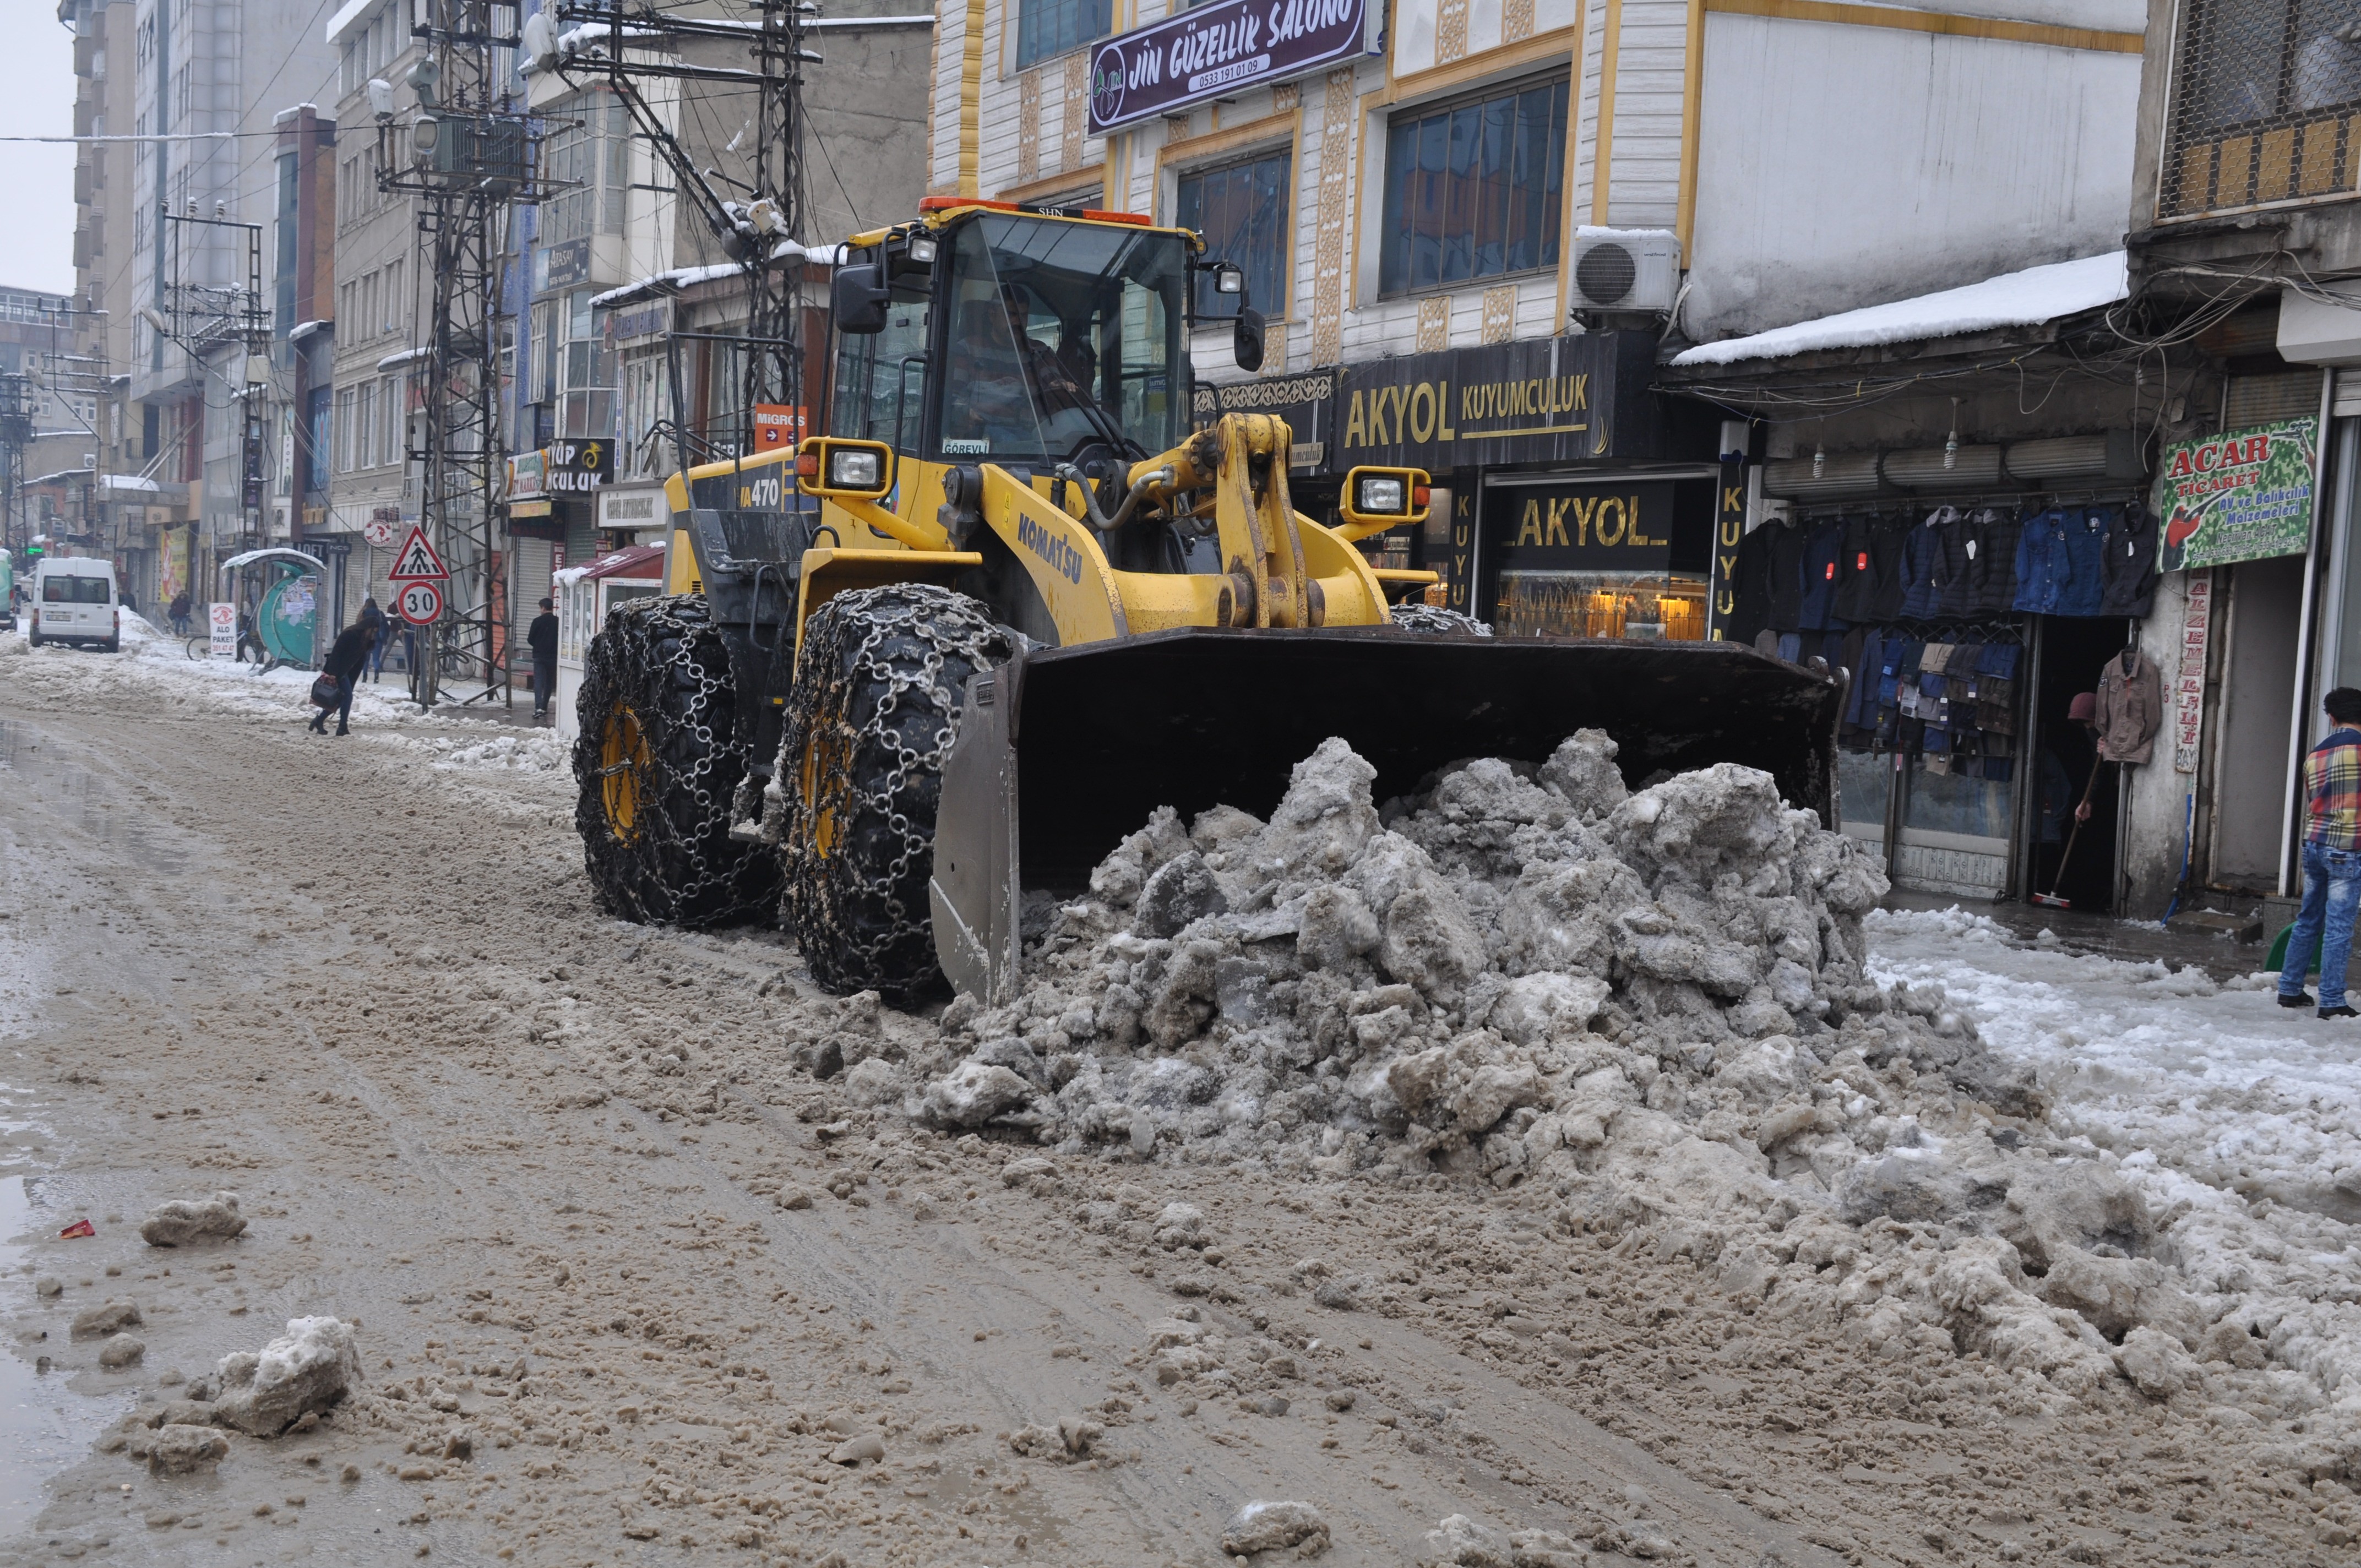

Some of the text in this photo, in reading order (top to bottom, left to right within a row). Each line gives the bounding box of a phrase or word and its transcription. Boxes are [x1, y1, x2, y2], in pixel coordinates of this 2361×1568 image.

[1129, 39, 1162, 90] JÎN
[1169, 5, 1260, 79] GÜZELLİK
[1199, 59, 1258, 88] 0533 191 01 09
[1038, 207, 1064, 217] SHN
[1344, 374, 1588, 448] AKYOL KUYUMCULUK
[944, 442, 987, 454] GÖREVLİ
[1291, 448, 1321, 464] umculuk
[2167, 434, 2271, 478] ACAR
[2177, 470, 2260, 497] TİCARET
[2219, 497, 2234, 511] AV
[2238, 498, 2252, 508] ve
[2226, 500, 2300, 525] Malzemeleri
[1516, 496, 1649, 547] AKYOL
[1018, 511, 1082, 585] KOMATSU
[1452, 496, 1470, 606] KUYU
[407, 592, 434, 613] 30
